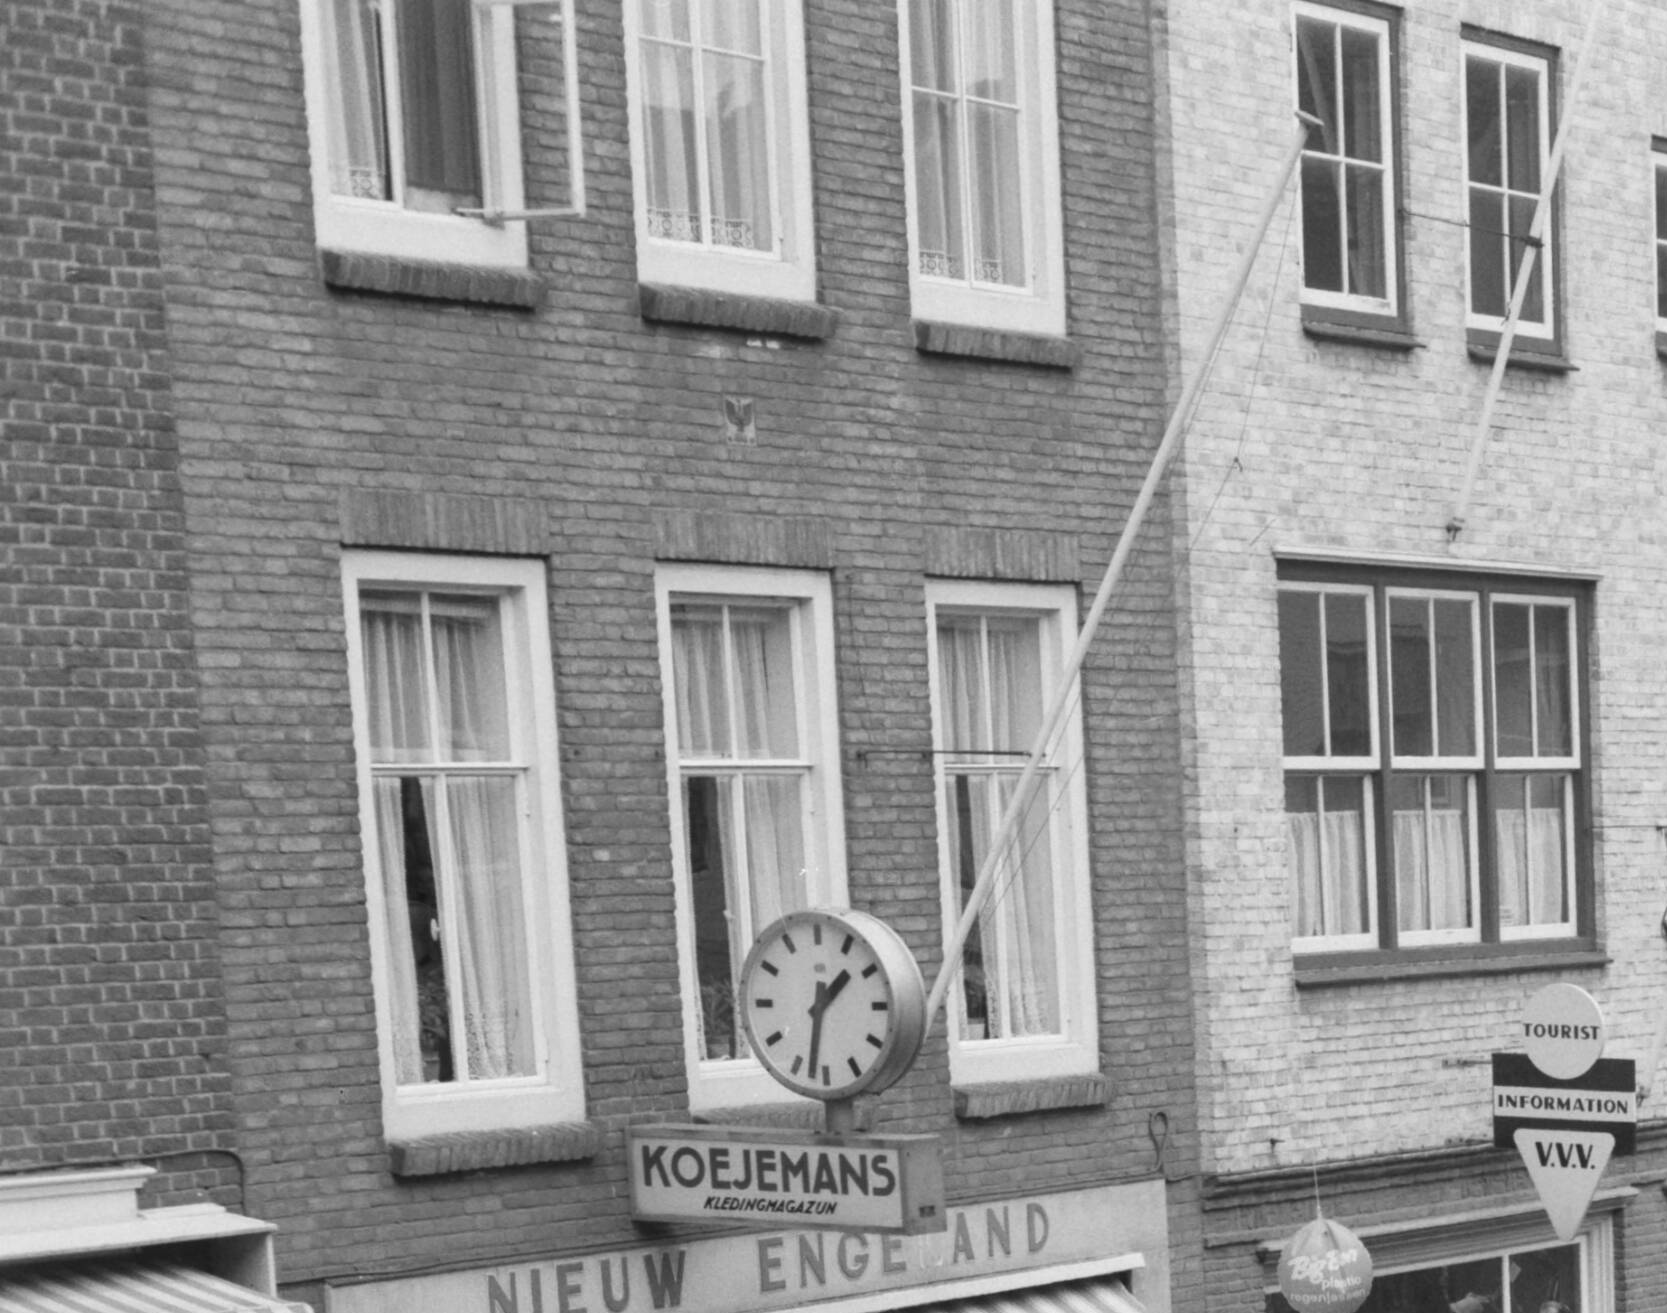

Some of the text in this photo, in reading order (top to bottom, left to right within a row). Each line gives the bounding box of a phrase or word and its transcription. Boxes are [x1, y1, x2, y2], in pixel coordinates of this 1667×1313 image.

[1523, 1022, 1600, 1041] TOURIST
[1497, 1093, 1629, 1115] INFORMATION
[1535, 1141, 1596, 1170] V.V.V.
[641, 1145, 897, 1198] KOEJEMANS
